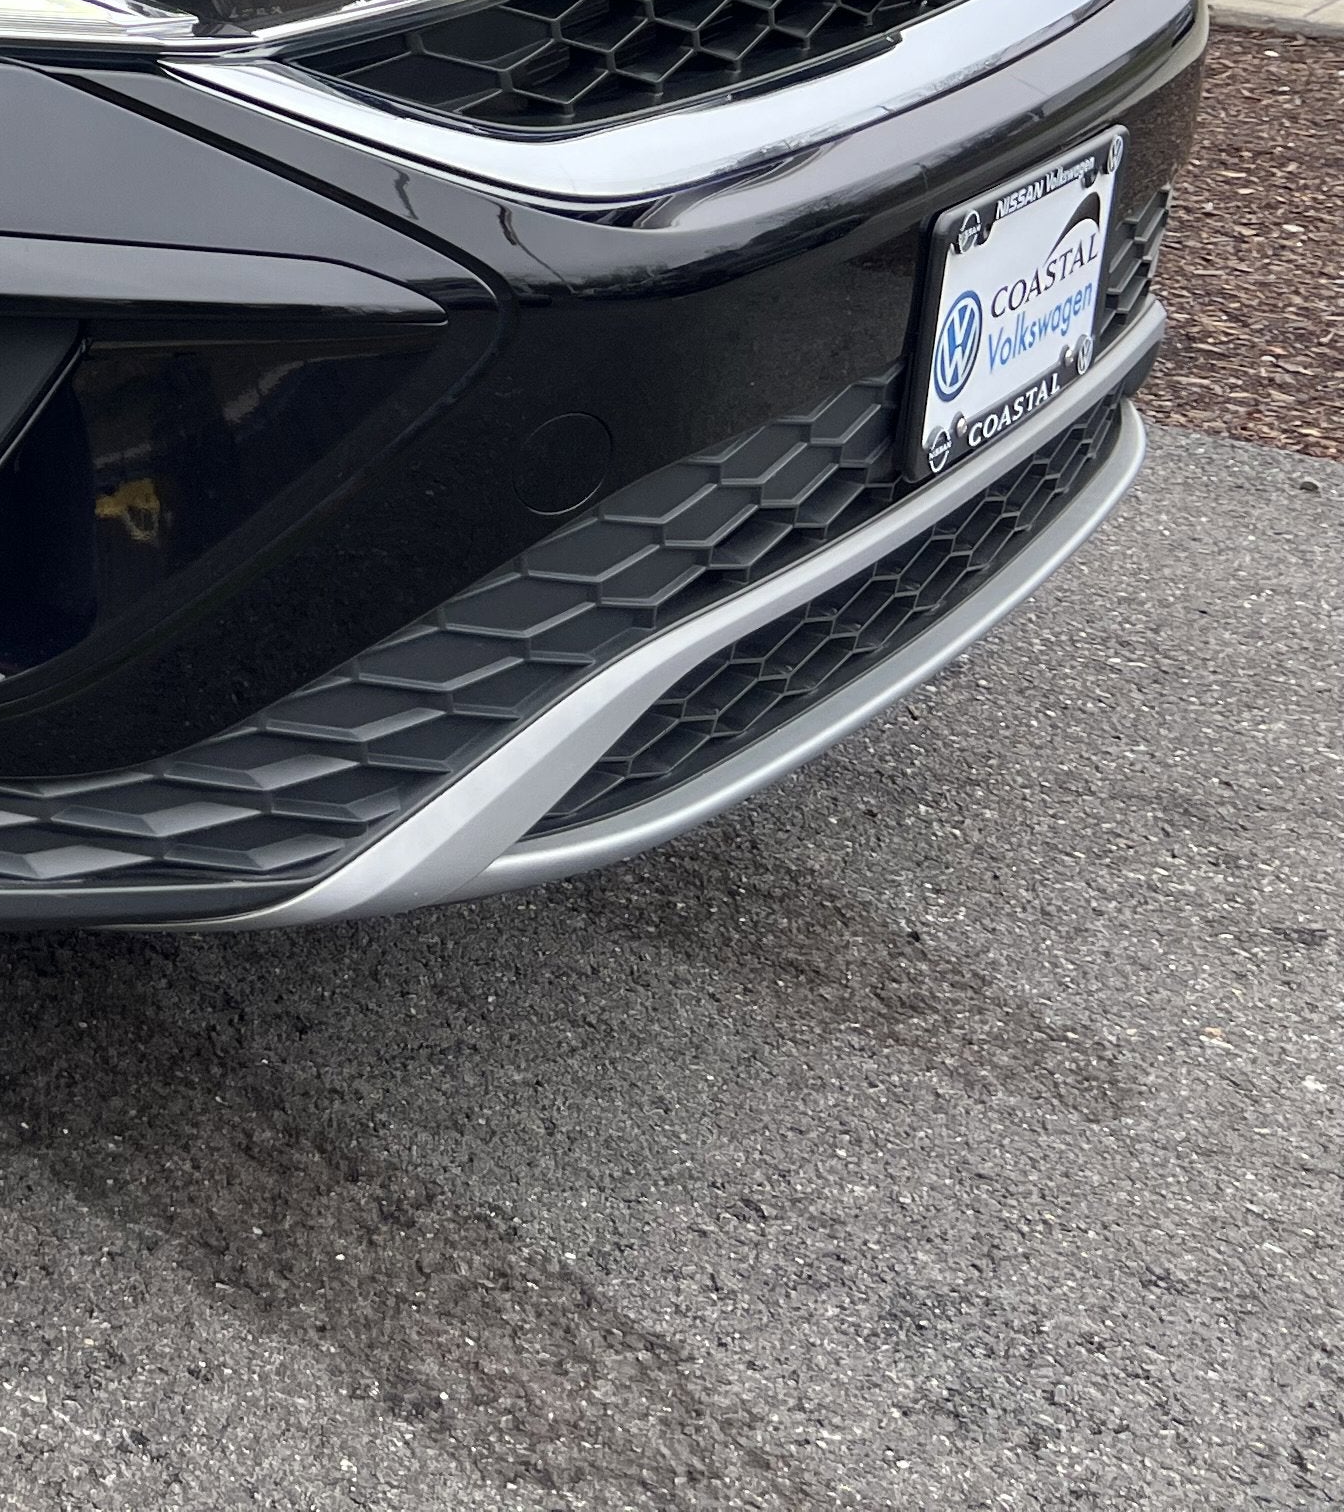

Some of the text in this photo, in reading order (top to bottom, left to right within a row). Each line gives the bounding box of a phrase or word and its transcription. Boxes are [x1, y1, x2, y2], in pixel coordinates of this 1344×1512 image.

[995, 156, 1095, 220] NISSAN Volkswagen
[991, 232, 1099, 319] COASTAL
[933, 290, 983, 402] VW
[987, 281, 1094, 374] Volkswagen
[968, 372, 1061, 447] COASTAL
